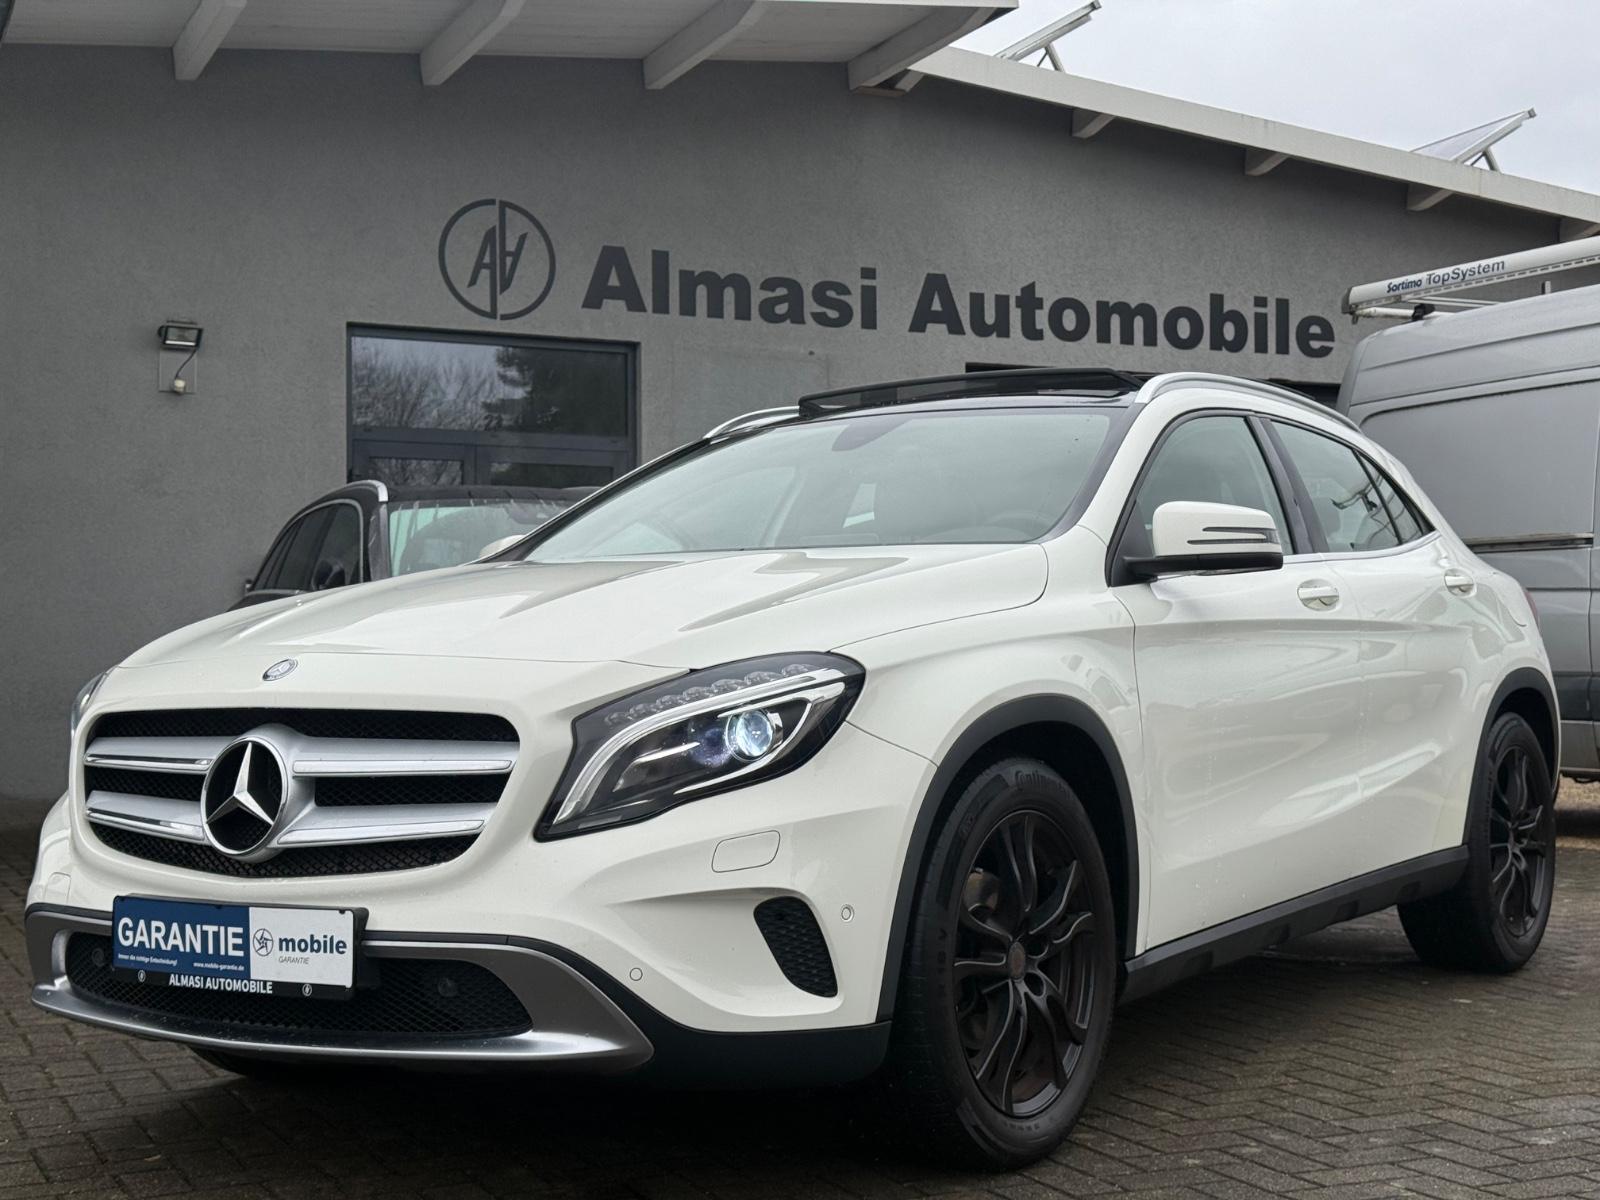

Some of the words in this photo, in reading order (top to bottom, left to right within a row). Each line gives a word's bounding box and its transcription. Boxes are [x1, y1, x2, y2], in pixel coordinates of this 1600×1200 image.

[1386, 278, 1422, 294] Sortimo
[1426, 260, 1505, 285] TopSystem
[581, 245, 878, 330] Almasi
[909, 273, 1336, 358] Automobile
[117, 917, 245, 957] GARANTIE
[278, 934, 347, 955] mobile
[278, 956, 310, 965] GARANTIE
[169, 974, 204, 988] ALMASI
[205, 976, 273, 994] AUTOMOBILE
